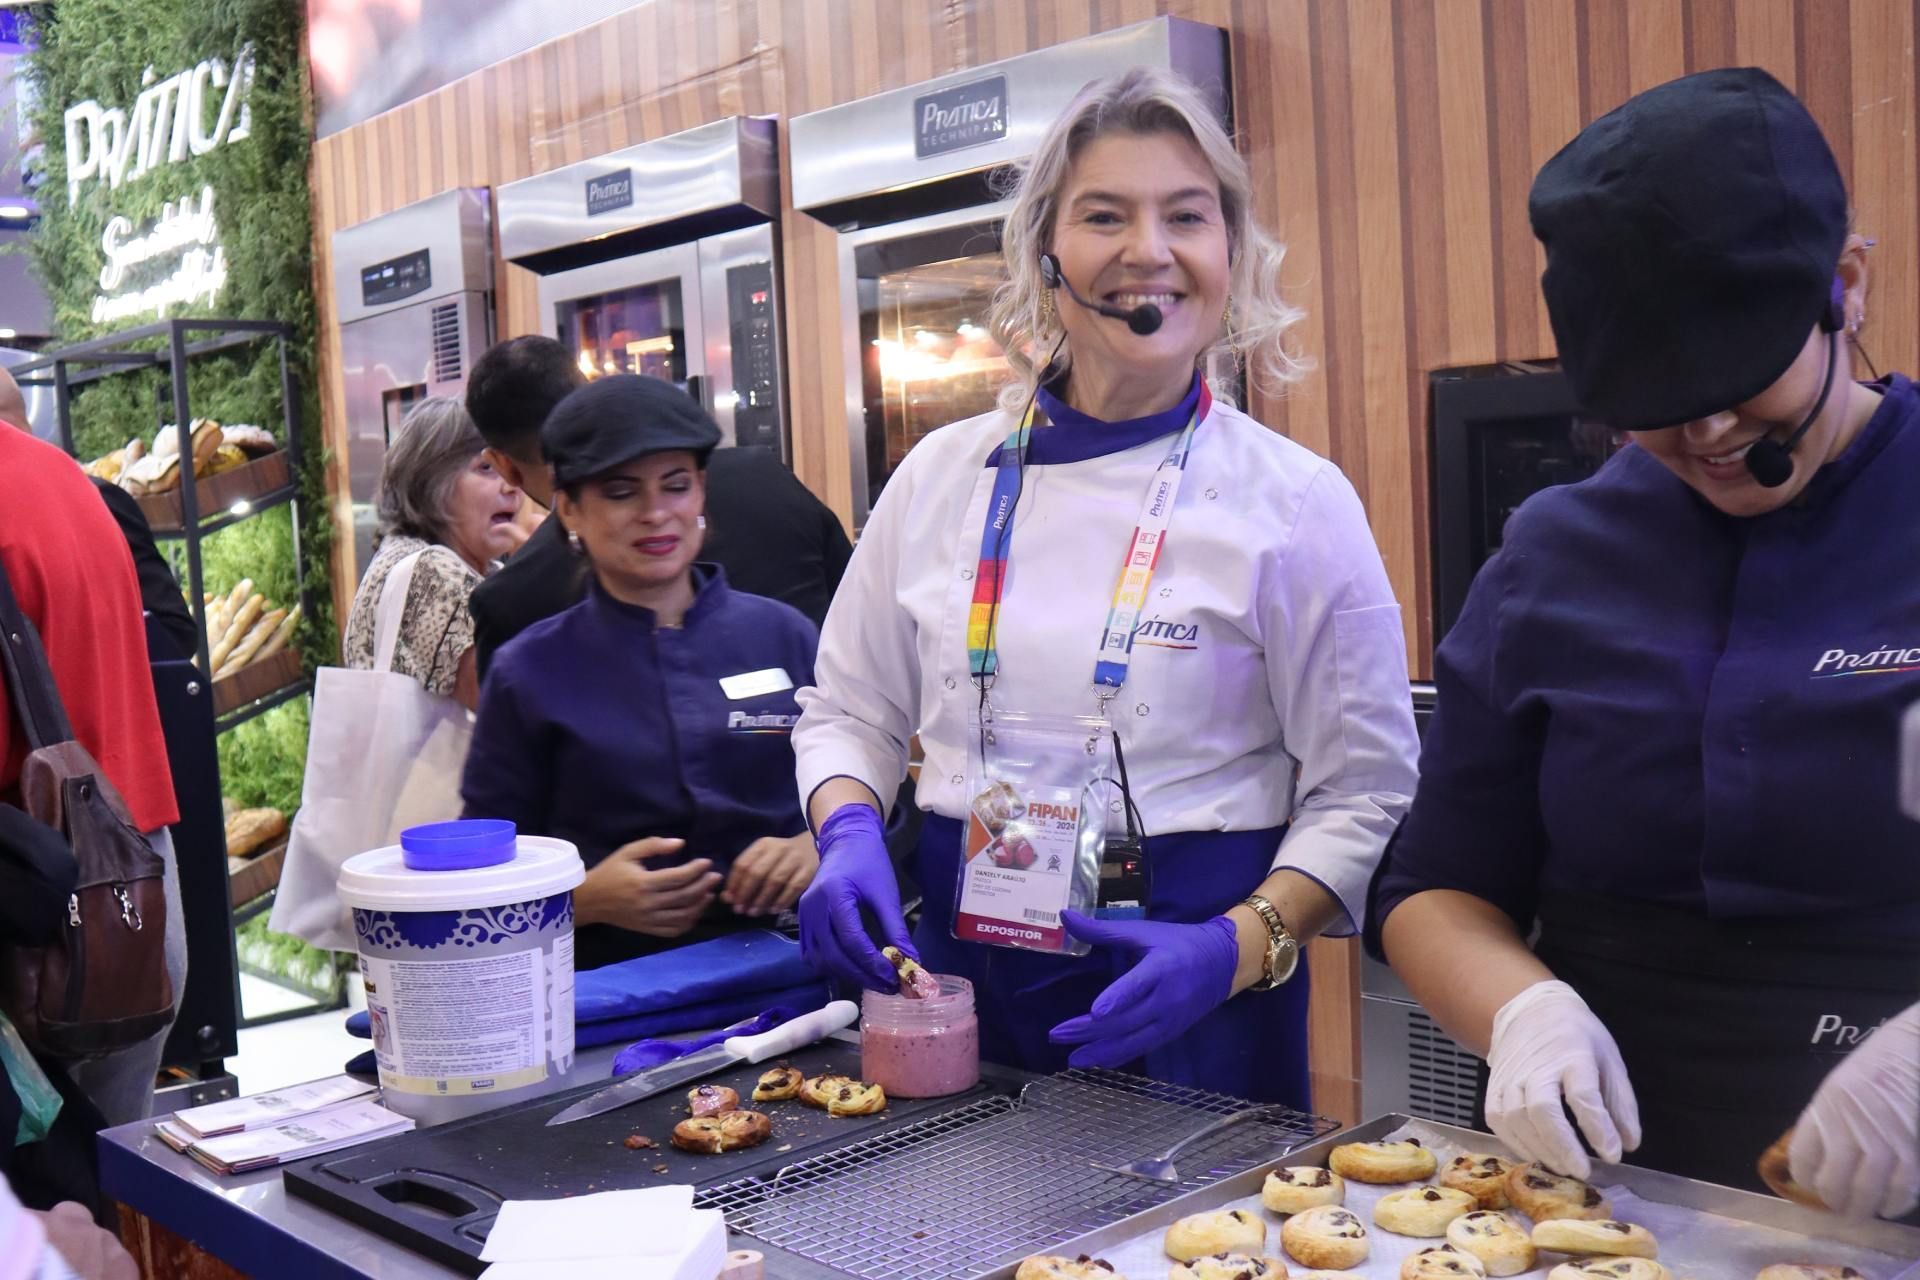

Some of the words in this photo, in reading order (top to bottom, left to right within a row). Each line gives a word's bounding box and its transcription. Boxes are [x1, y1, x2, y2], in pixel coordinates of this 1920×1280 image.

[64, 44, 256, 209] PRÁTICA
[921, 95, 999, 134] PRÁTICA
[922, 119, 1003, 147] TECHNIPAN
[1133, 614, 1199, 641] ÁTICA
[1812, 644, 1920, 672] PRÁTIC
[1028, 803, 1077, 821] FIPAN
[1056, 821, 1076, 831] 2024
[976, 924, 1042, 940] EXPOSITOR
